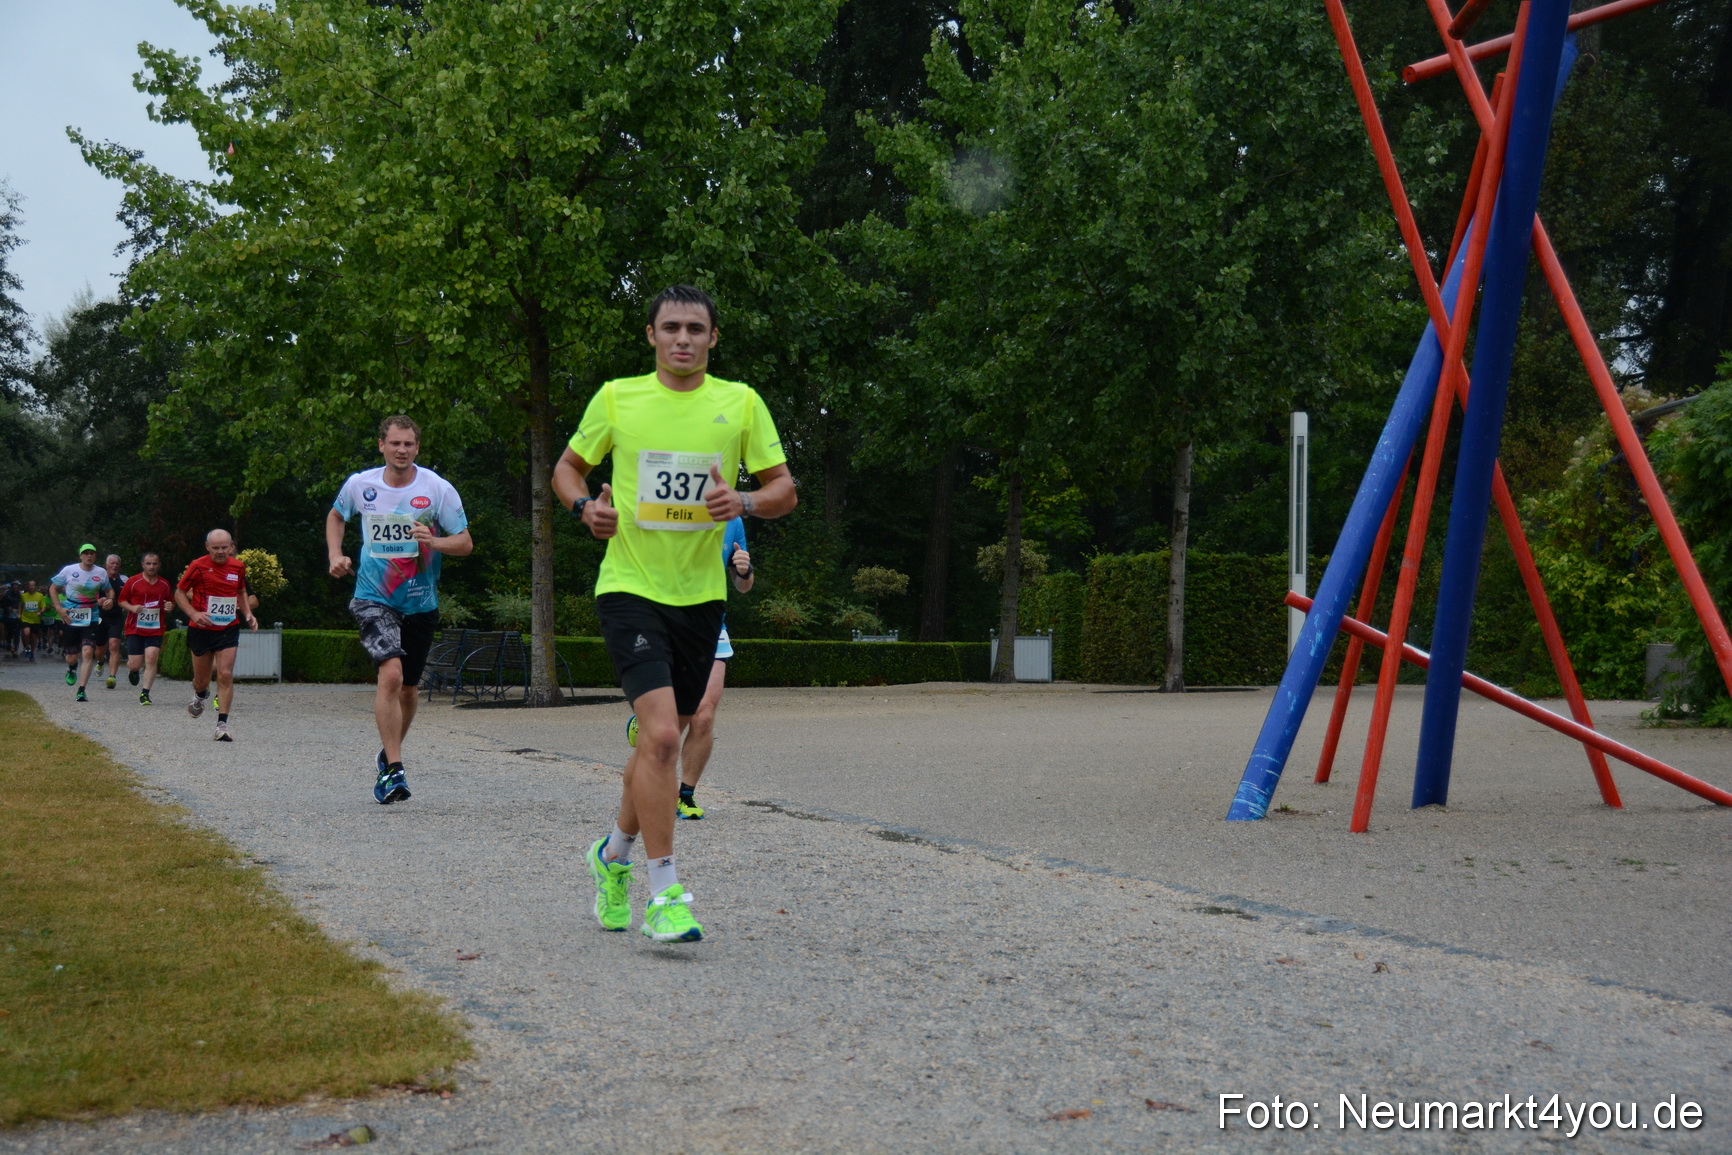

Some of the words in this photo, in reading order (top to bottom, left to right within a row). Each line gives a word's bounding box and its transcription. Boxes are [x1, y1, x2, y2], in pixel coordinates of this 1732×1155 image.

[656, 471, 709, 501] 337
[666, 508, 693, 520] Felix
[372, 524, 413, 541] 2439
[382, 545, 404, 553] Tobias
[211, 603, 235, 615] 2438
[140, 613, 158, 622] 2417
